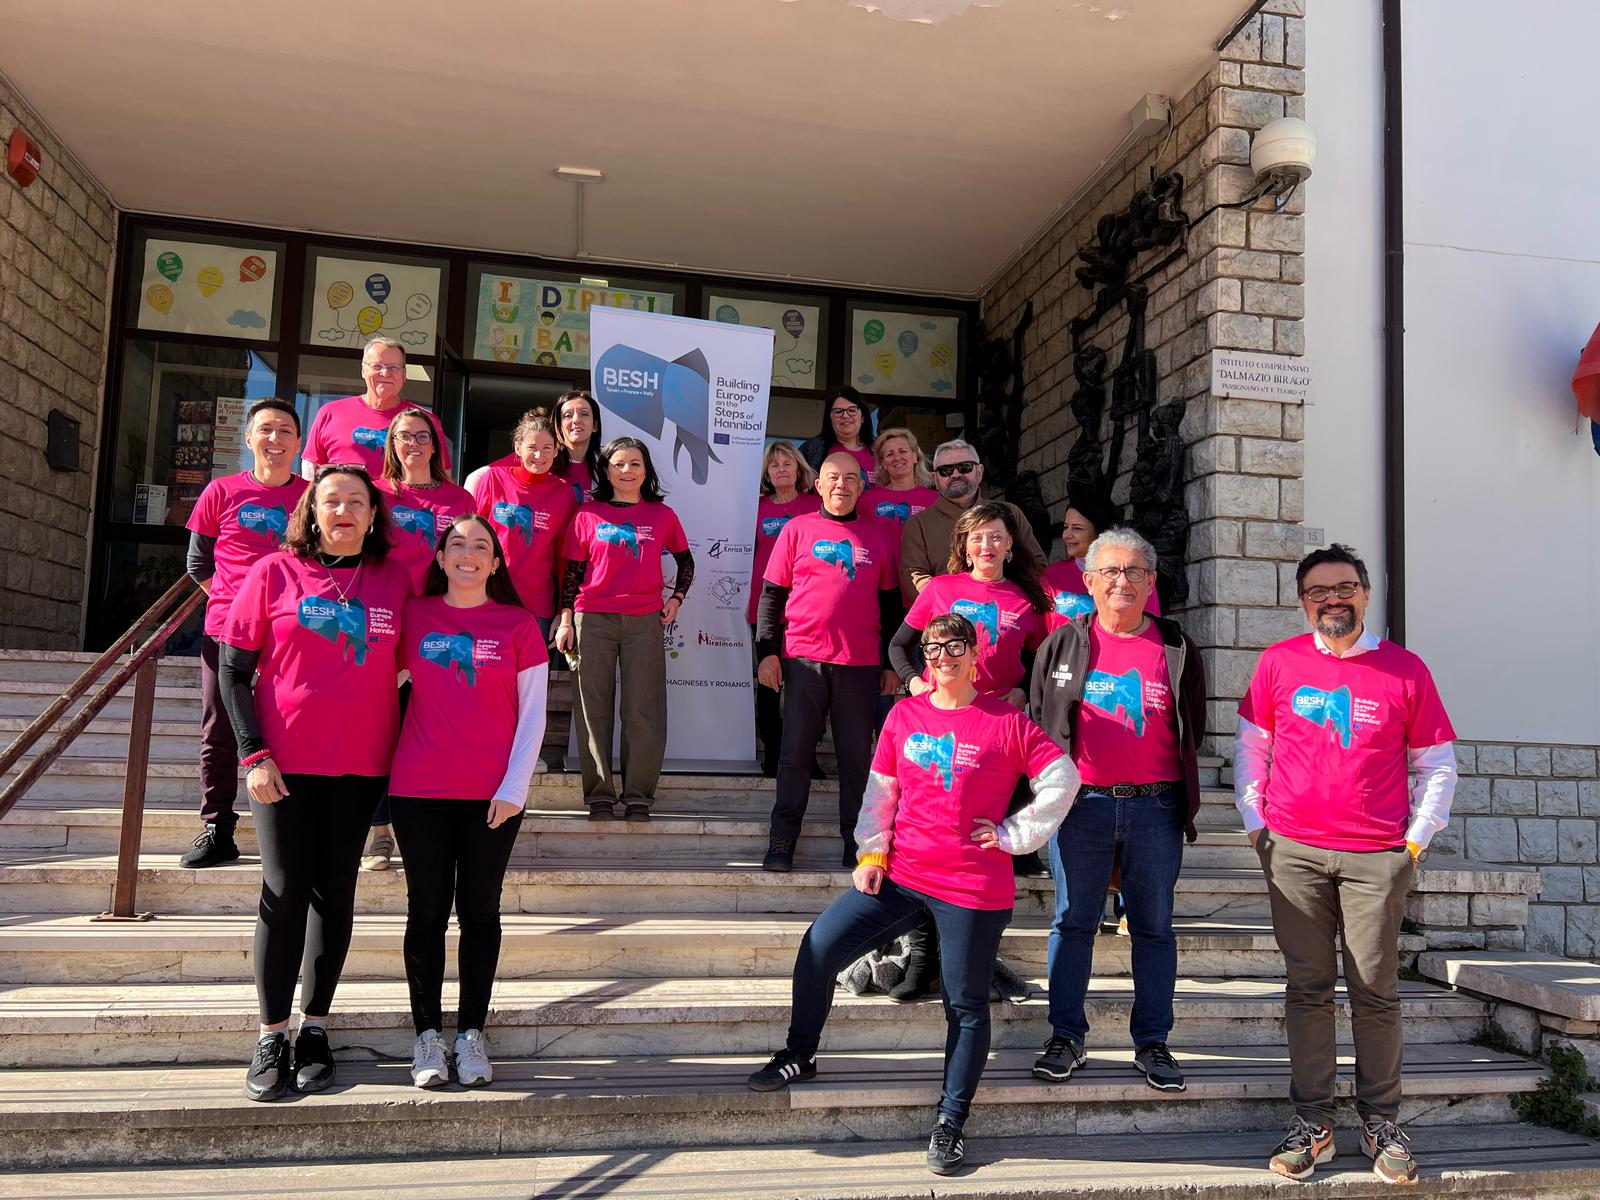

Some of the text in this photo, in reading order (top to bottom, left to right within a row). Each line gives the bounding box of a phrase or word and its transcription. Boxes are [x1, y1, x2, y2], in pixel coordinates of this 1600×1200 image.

[497, 281, 513, 304] I
[1220, 358, 1310, 373] ISTITUTO COMPRENSIVO
[603, 367, 659, 390] BESH
[716, 377, 760, 393] Building
[716, 390, 754, 404] Europe
[726, 400, 738, 408] the
[715, 407, 745, 420] Steps
[714, 418, 762, 431] Hannibal
[241, 511, 265, 520] BESH
[1308, 531, 1318, 542] 15
[302, 605, 336, 617] BESH
[423, 640, 451, 650] BESH
[666, 679, 709, 687] HAGINESES
[1085, 681, 1115, 692] BESH
[1295, 695, 1325, 706] BESH
